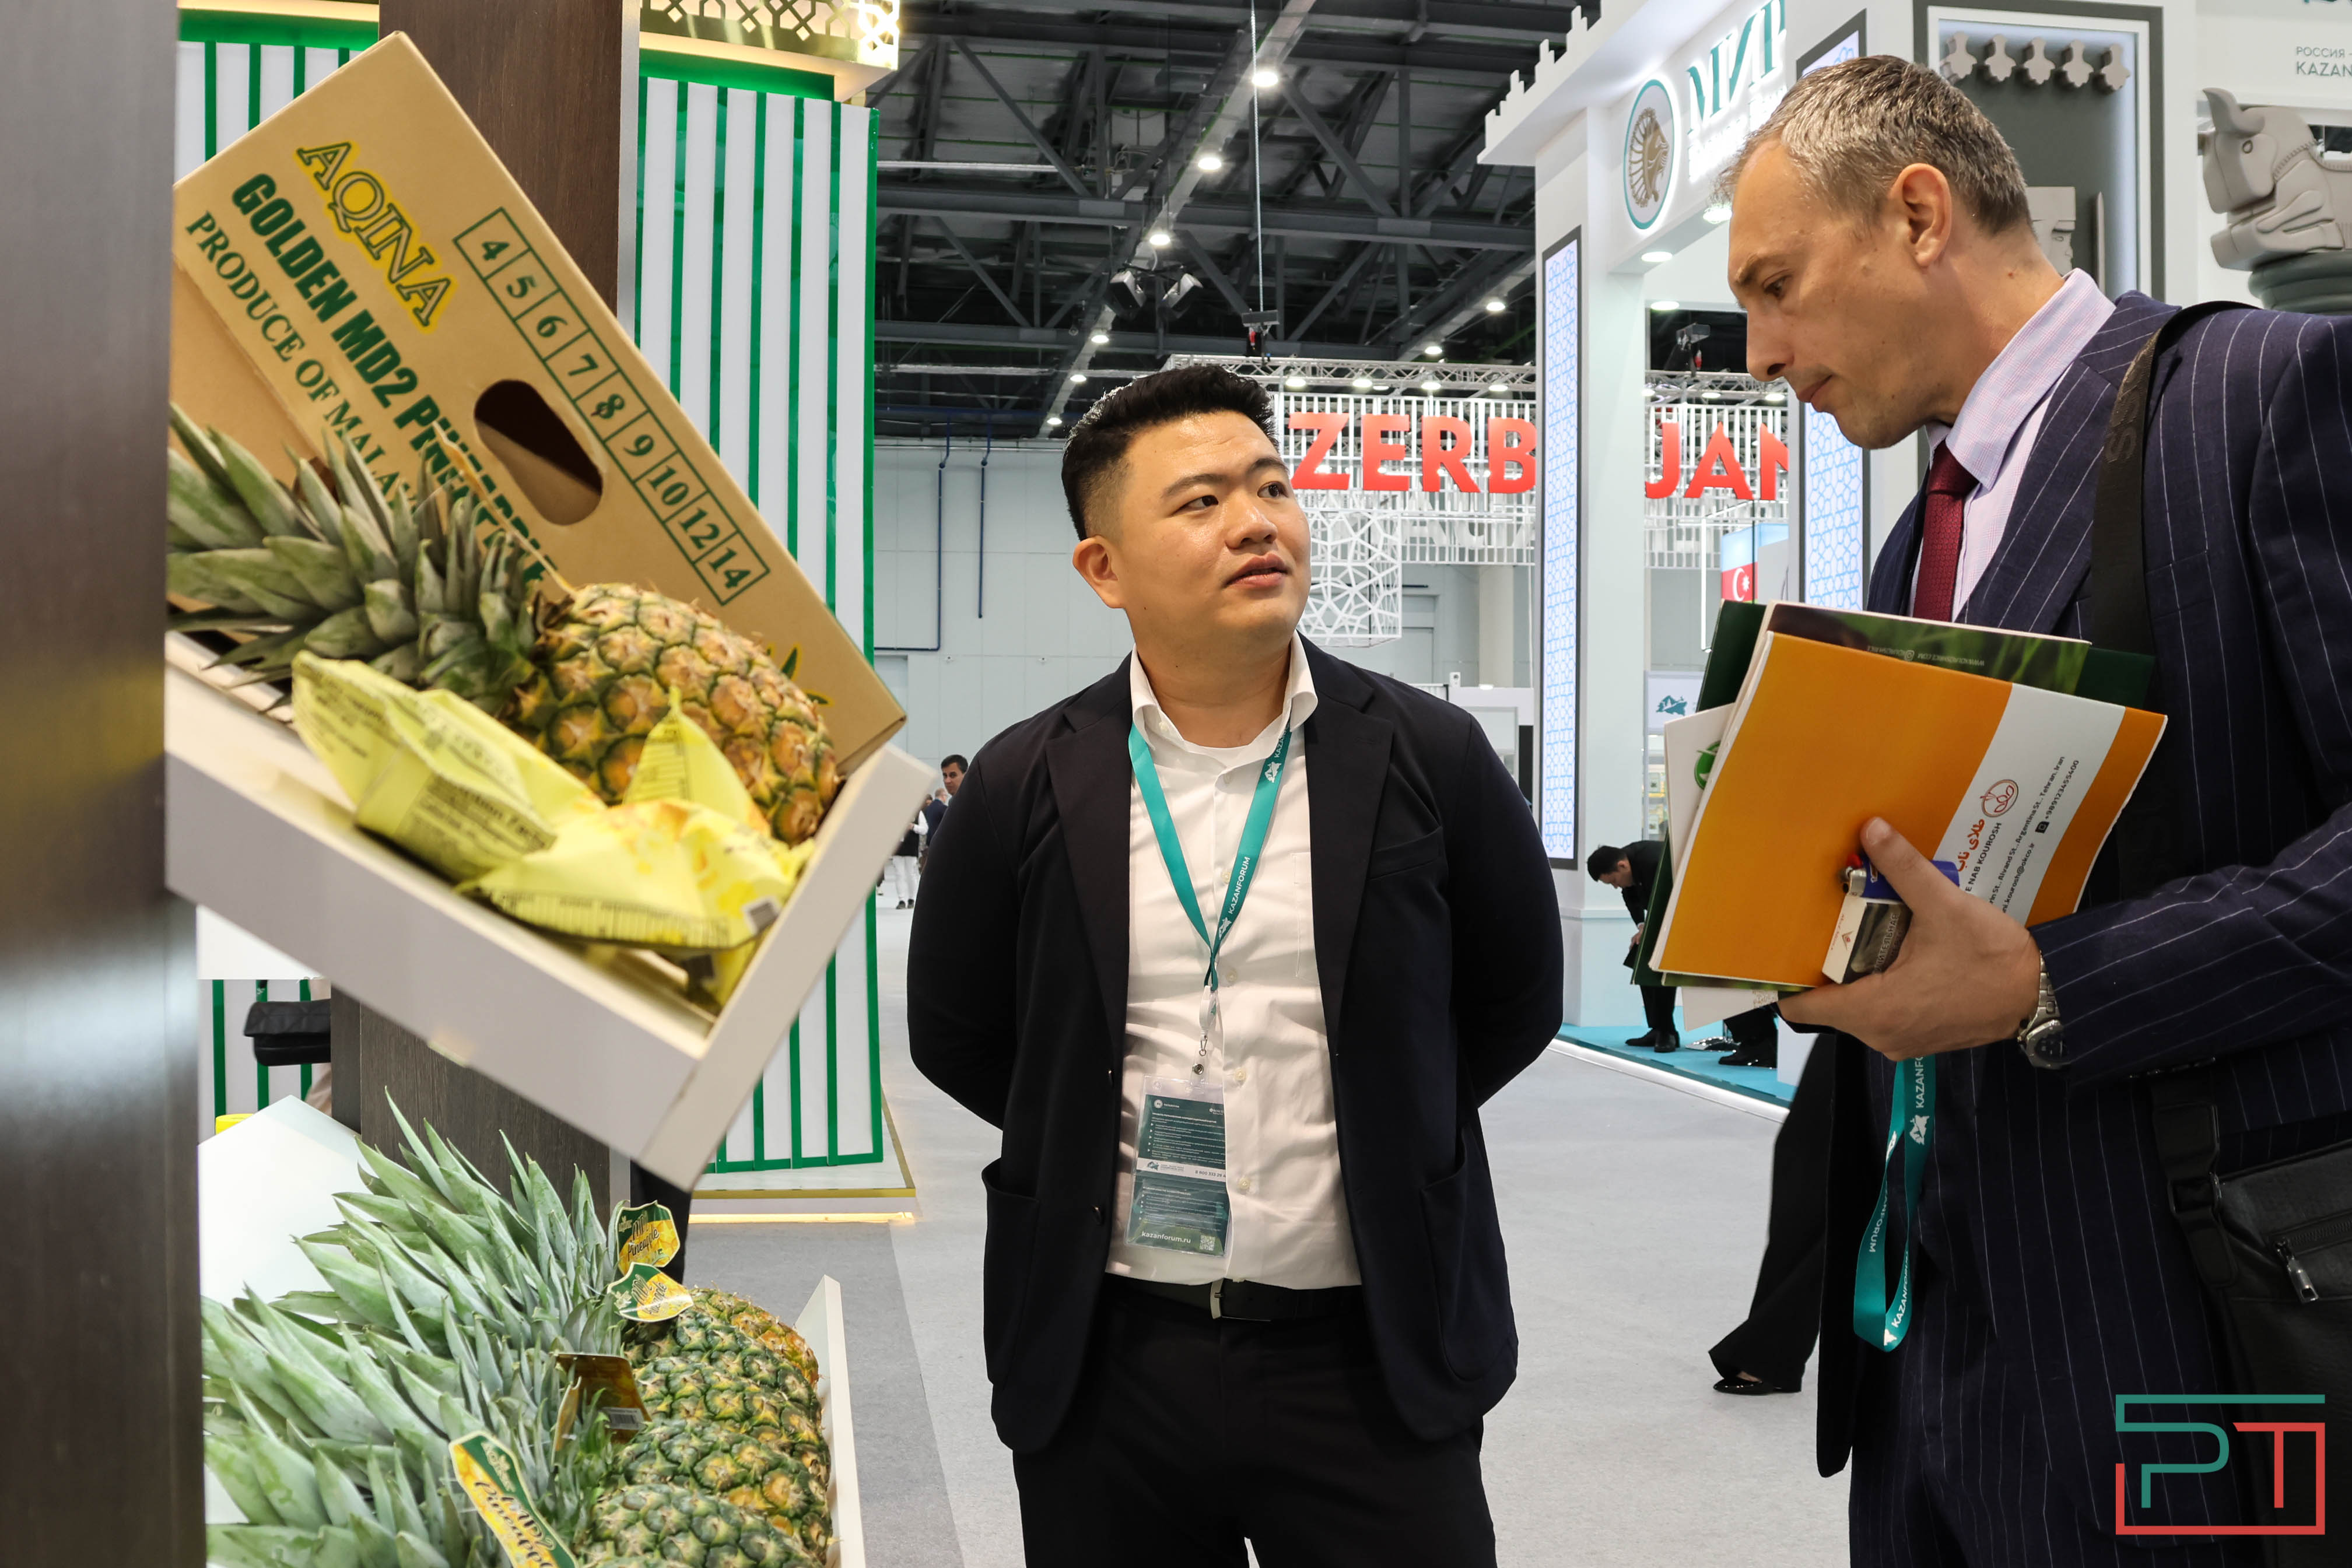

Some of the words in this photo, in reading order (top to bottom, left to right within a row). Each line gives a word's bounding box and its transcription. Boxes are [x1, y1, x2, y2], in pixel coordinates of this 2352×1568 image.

[2296, 46, 2345, 58] РОССИЯ
[296, 142, 452, 327] AQINA
[481, 240, 509, 261] 4
[185, 211, 305, 362] PRODUCE
[295, 359, 340, 402] OF
[232, 173, 356, 323] GOLDEN
[331, 308, 418, 408] MD2
[506, 275, 537, 299] 5
[536, 315, 567, 338] 6
[568, 353, 598, 377] 7
[595, 394, 625, 419] 8
[623, 434, 654, 457] 9
[647, 465, 689, 506] 10
[678, 507, 720, 541] 12
[709, 548, 751, 589] 14
[2044, 759, 2079, 819] +989123455400
[1998, 855, 2013, 881] Alvand
[2015, 808, 2036, 843] Argentina
[2054, 756, 2065, 771] Iran
[1969, 866, 1981, 885] NAB
[1978, 822, 2002, 864] KOUROSH
[1228, 857, 1250, 914] KAZANFORUM
[1874, 913, 1899, 970] ИТЕЛЬНАЯ
[1141, 1231, 1191, 1244] kazanforum.ru
